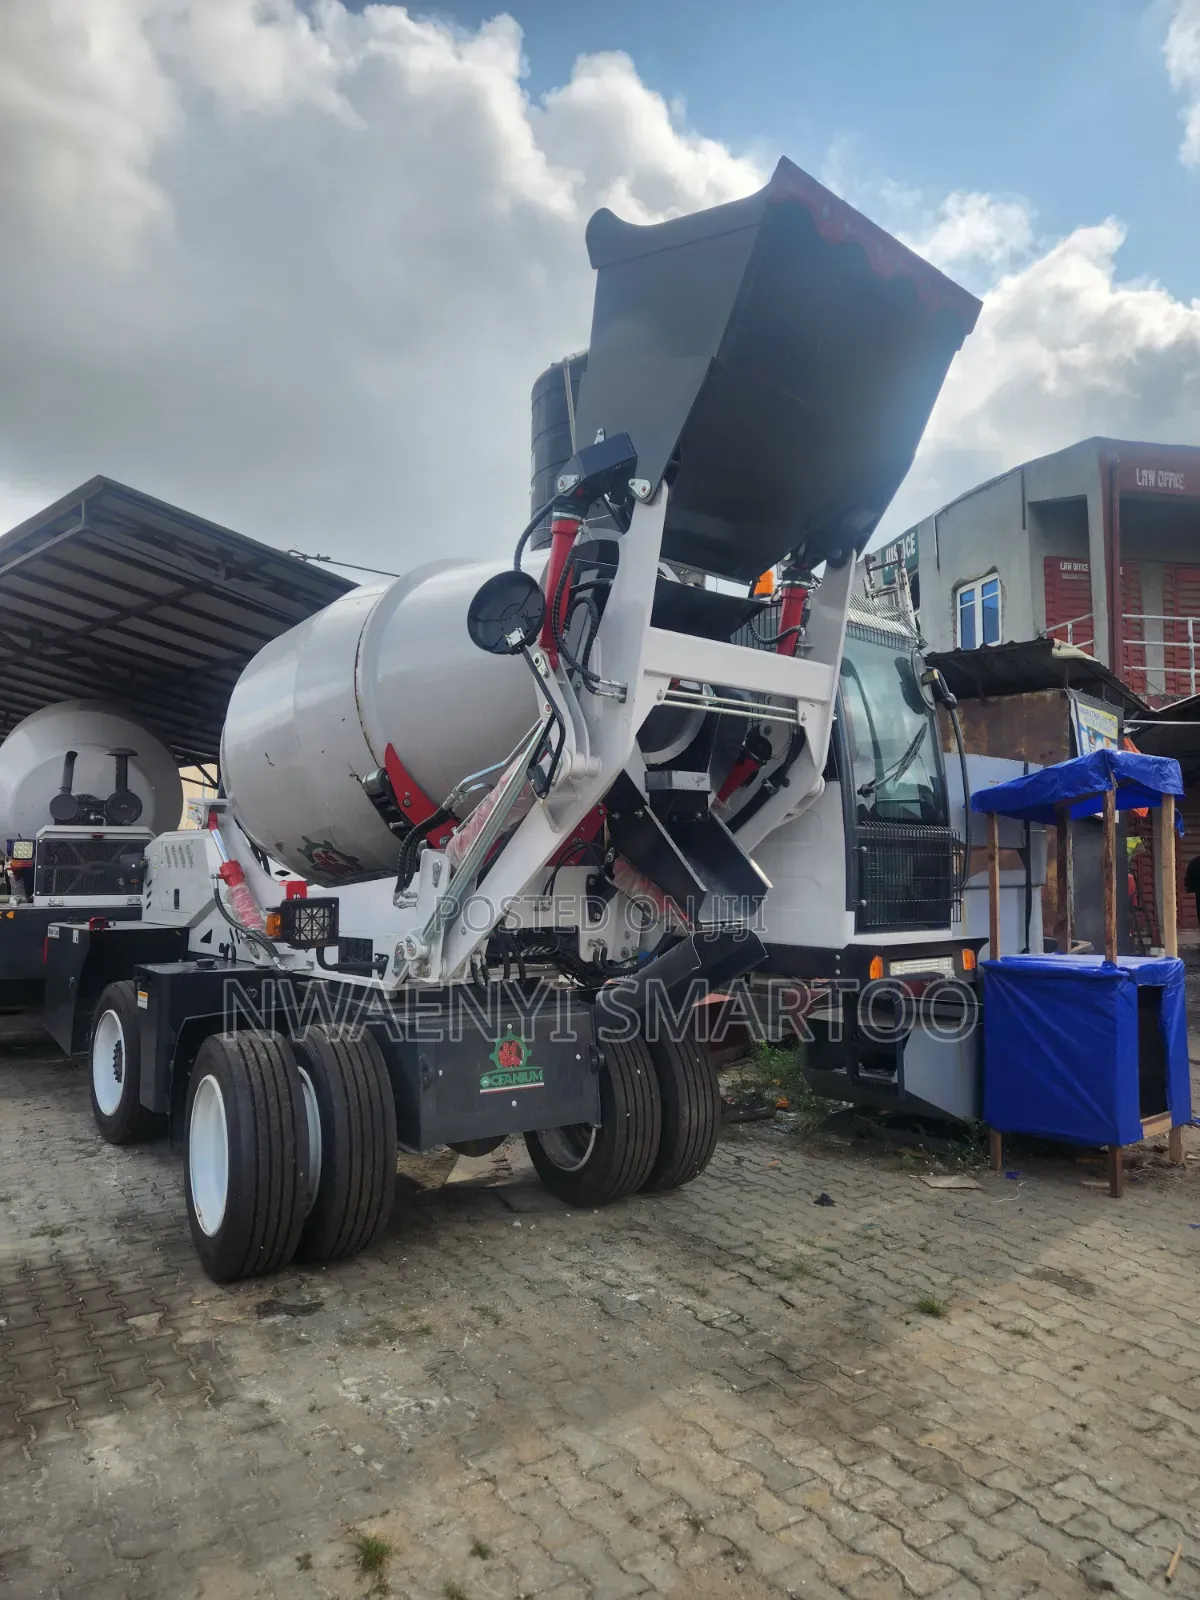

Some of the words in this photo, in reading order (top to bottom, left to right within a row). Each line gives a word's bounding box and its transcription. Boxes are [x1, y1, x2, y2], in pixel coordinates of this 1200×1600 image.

[1136, 468, 1155, 487] LAW
[1158, 470, 1185, 490] OFFICE
[1060, 561, 1073, 571] LAW
[1073, 562, 1089, 572] OFFICE
